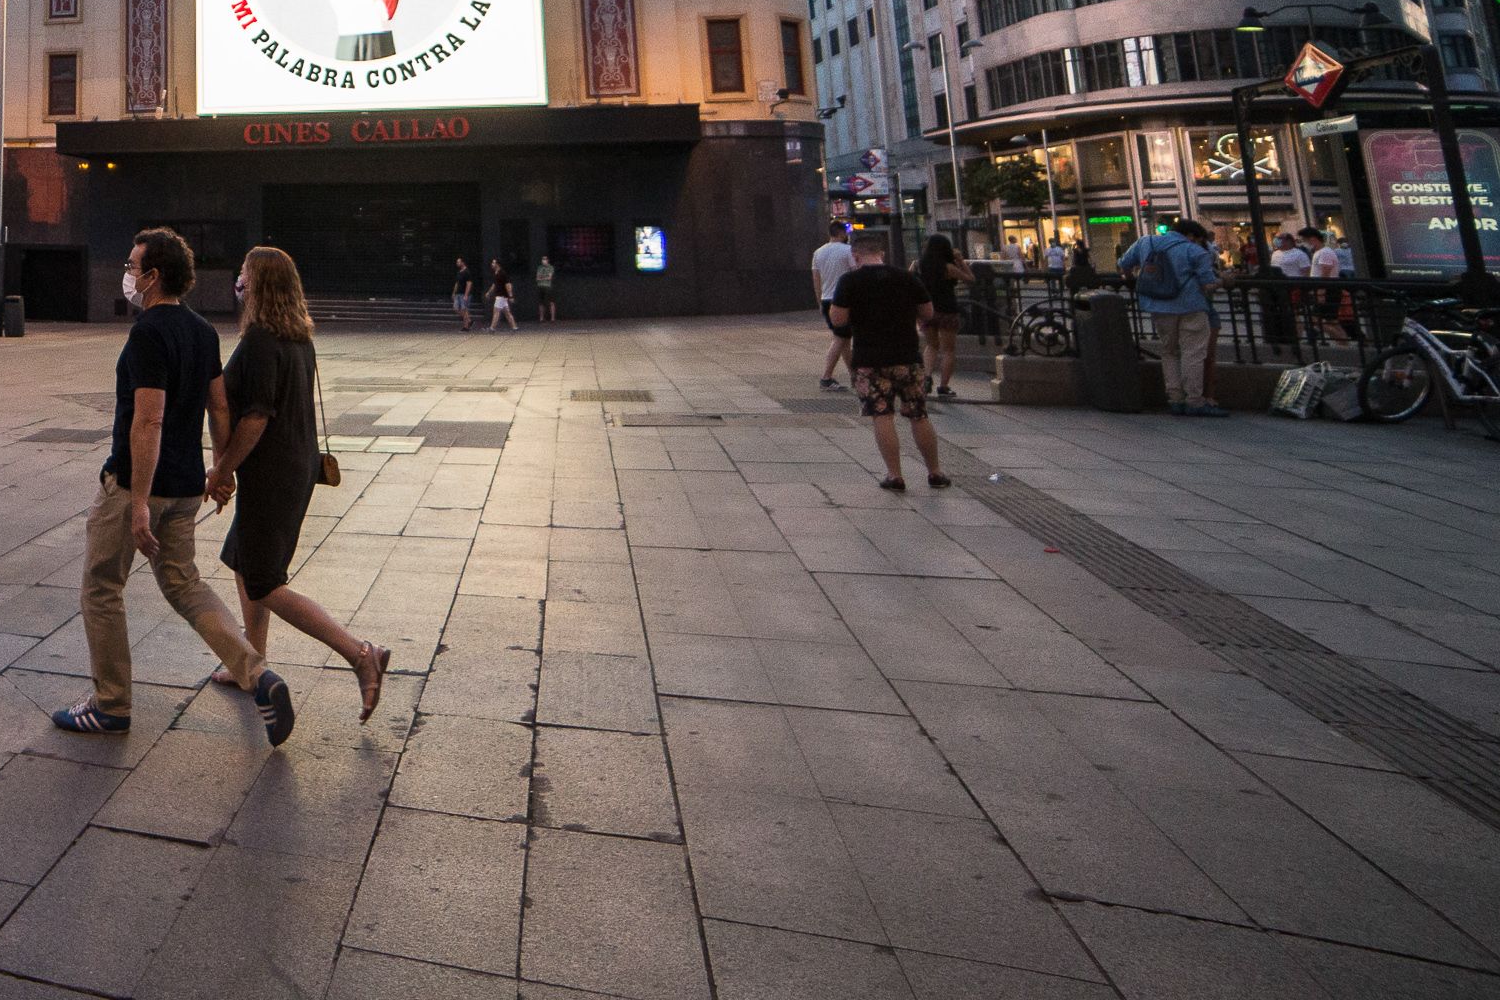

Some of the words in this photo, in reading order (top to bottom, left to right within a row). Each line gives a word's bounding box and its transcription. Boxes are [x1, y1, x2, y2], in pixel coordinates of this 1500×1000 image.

[252, 29, 356, 89] PALABRA
[366, 32, 466, 89] CONTRA
[460, 0, 491, 31] LA
[243, 121, 331, 144] CINES
[351, 117, 470, 142] CALLAO
[1316, 123, 1338, 133] Callao
[1391, 183, 1487, 193] CONSTRYE.
[1391, 196, 1405, 205] SI
